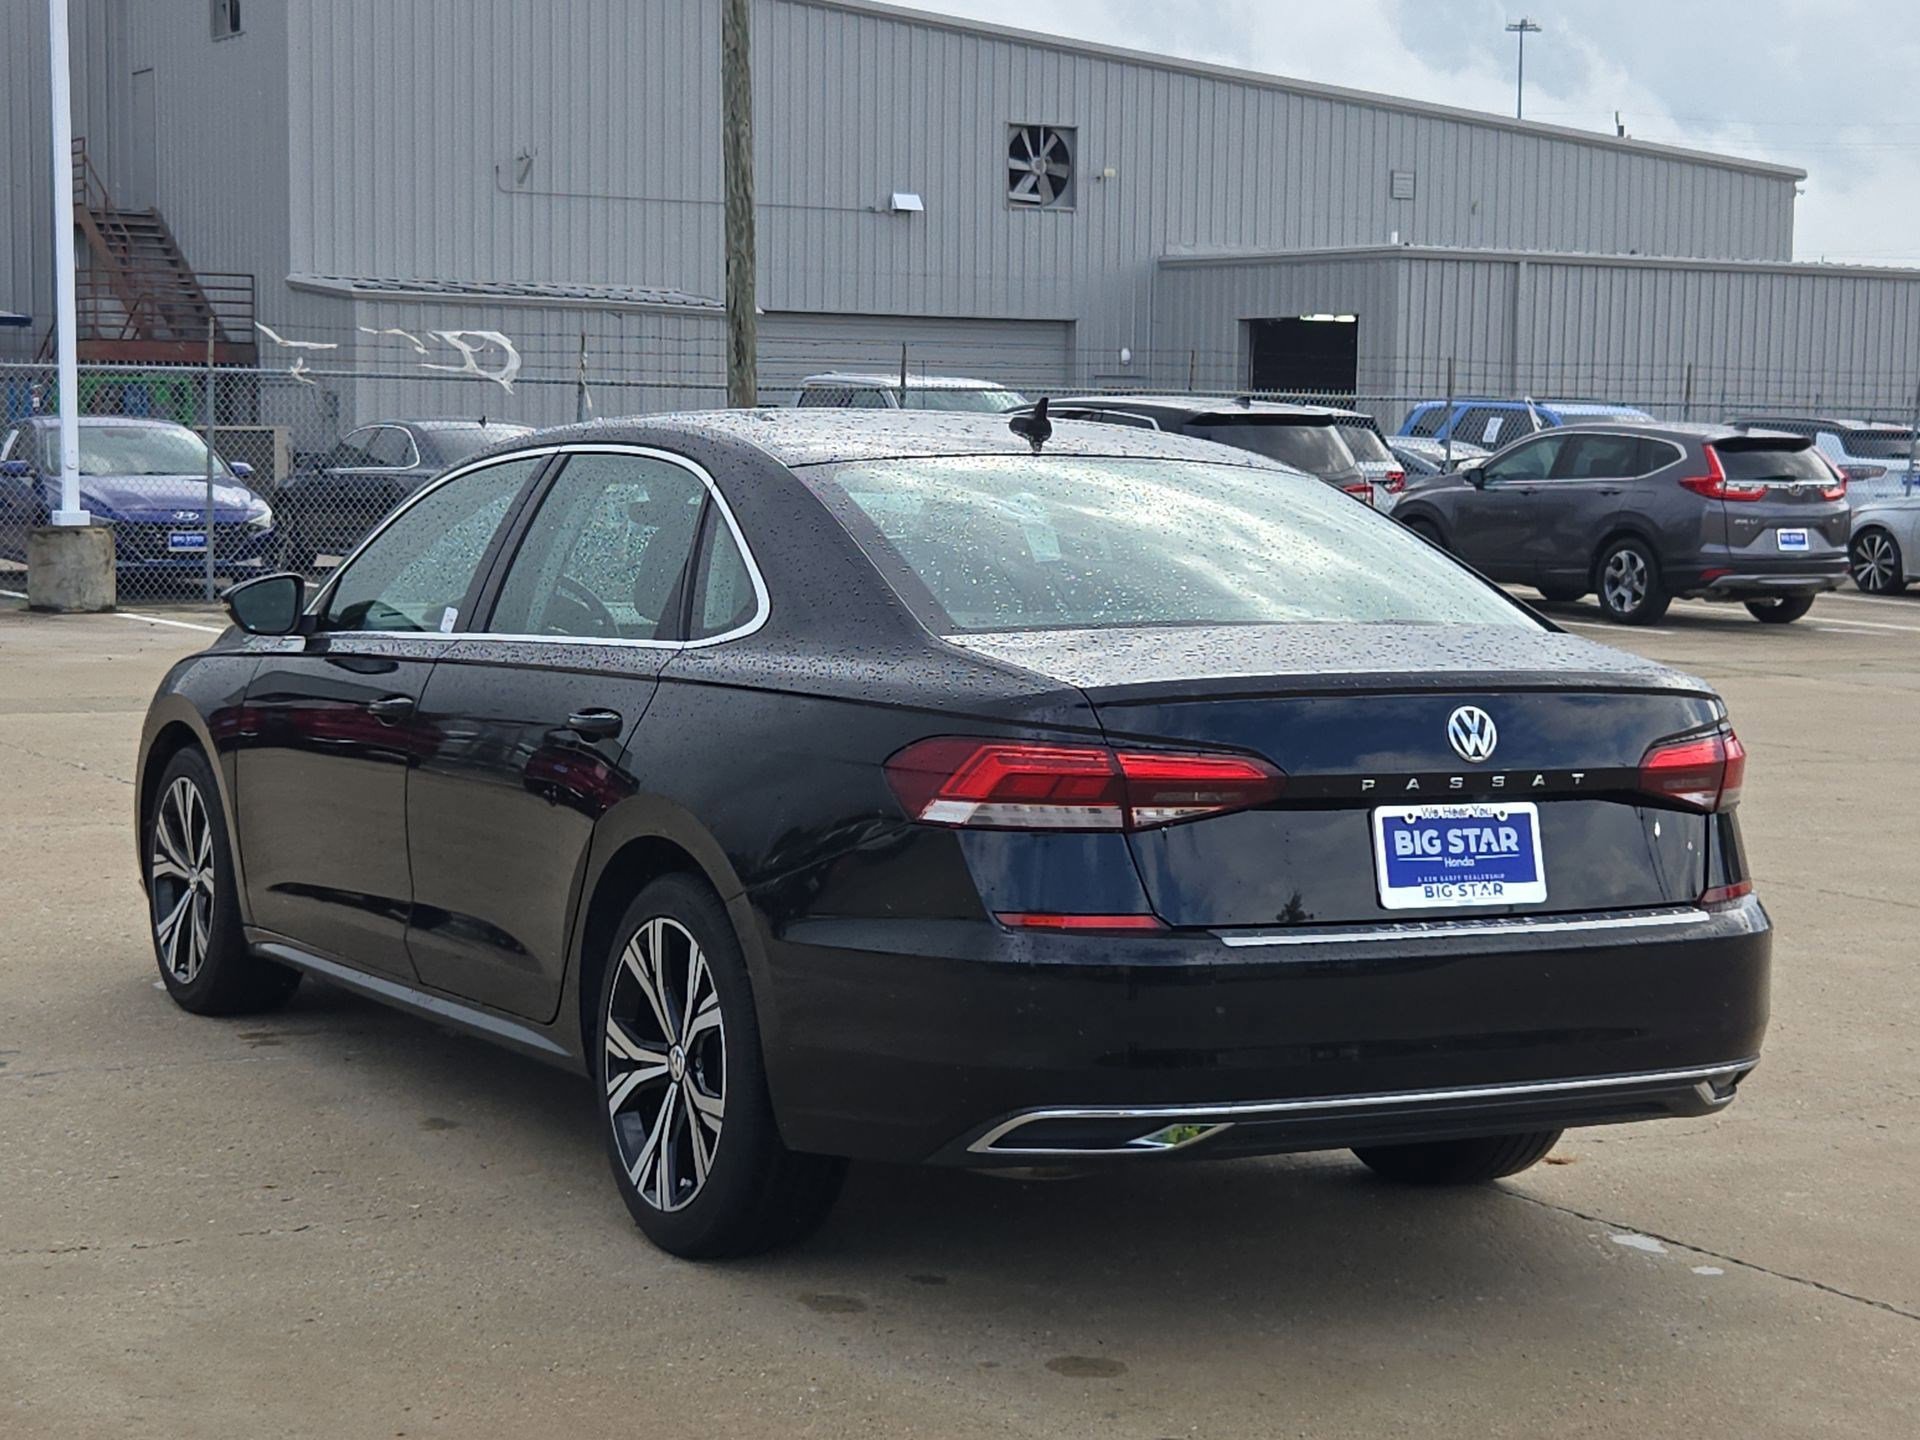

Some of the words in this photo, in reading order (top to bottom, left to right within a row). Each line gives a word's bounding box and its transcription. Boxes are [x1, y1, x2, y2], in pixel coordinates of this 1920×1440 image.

[1361, 773, 1584, 791] PASSAT
[1393, 829, 1442, 856] BIG
[1447, 827, 1520, 854] STAR
[1444, 856, 1475, 868] Honda
[1424, 885, 1453, 898] BIG
[1458, 882, 1504, 897] STAR
